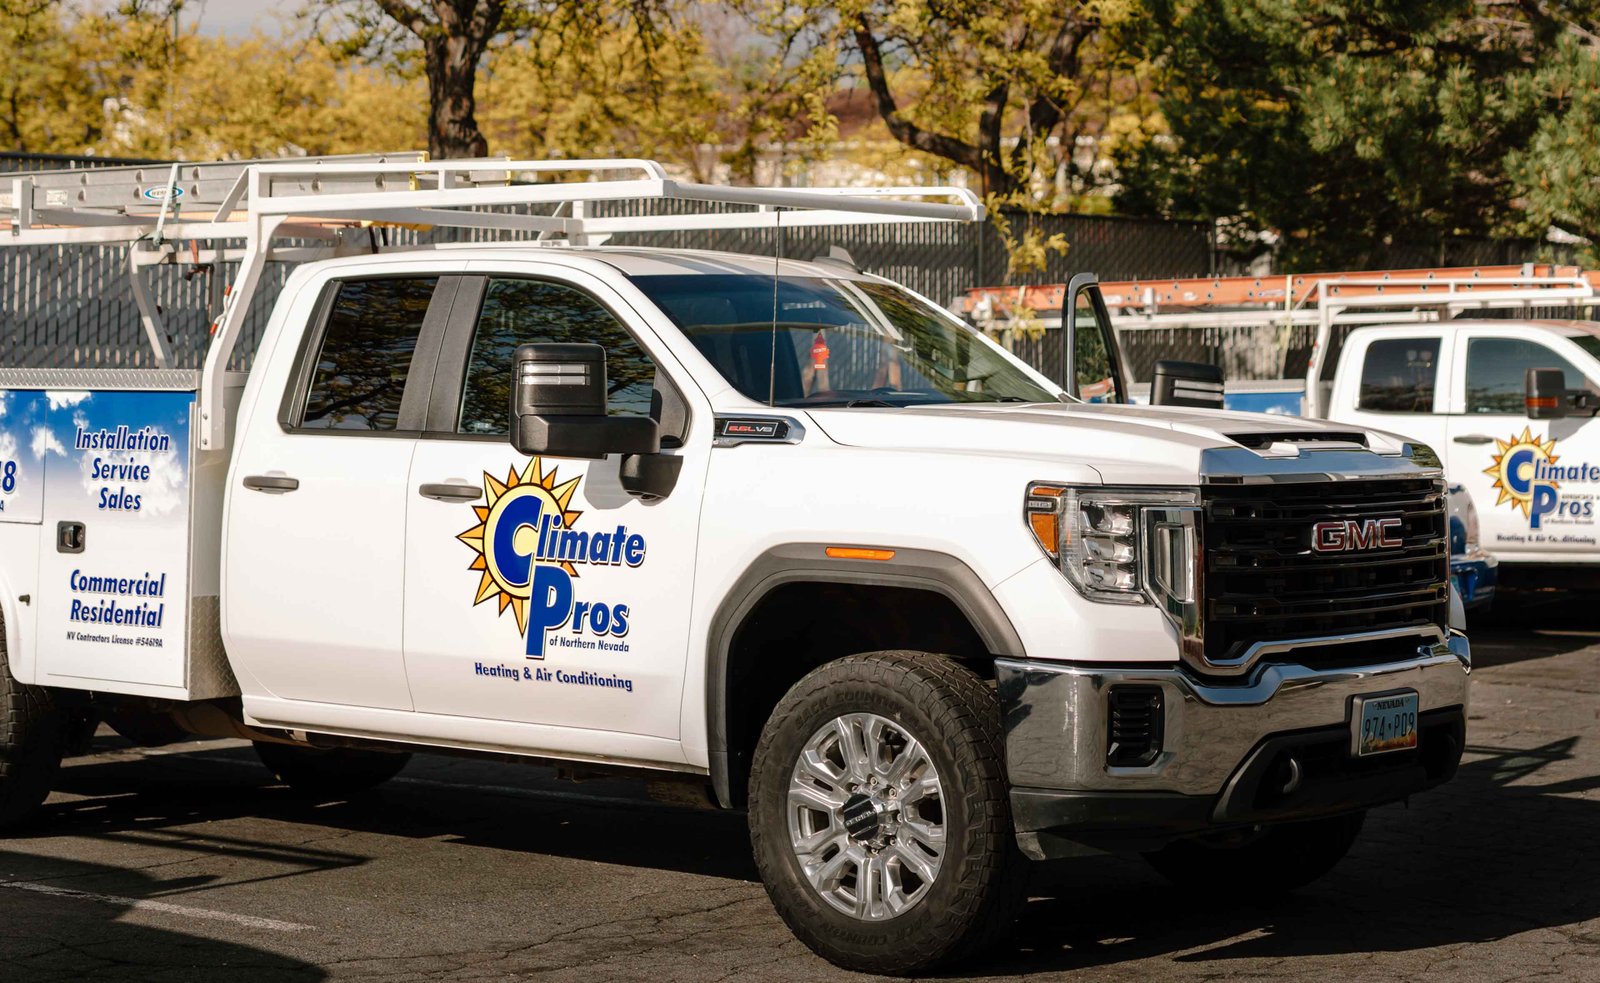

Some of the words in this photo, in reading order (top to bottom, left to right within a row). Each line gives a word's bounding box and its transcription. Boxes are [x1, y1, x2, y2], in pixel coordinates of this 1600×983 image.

[75, 425, 170, 451] Installation
[0, 460, 17, 493] 8
[92, 457, 150, 481] Service
[1506, 449, 1600, 494] Climate
[98, 487, 141, 511] Sales
[1530, 485, 1594, 530] Pros
[493, 494, 646, 587] Climate
[1313, 518, 1403, 551] GMC
[70, 569, 166, 597] Commercial
[70, 599, 164, 628] Residential
[526, 565, 630, 659] Pros
[66, 631, 76, 640] NV
[76, 632, 110, 643] Contractors
[111, 634, 134, 645] License
[549, 635, 559, 646] of
[560, 637, 596, 650] Northern
[598, 640, 630, 652] Nevada
[475, 662, 520, 682] Heating
[523, 667, 533, 680] &
[536, 667, 553, 682] Air
[556, 669, 633, 692] Conditioning
[1376, 698, 1405, 711] NEVADA
